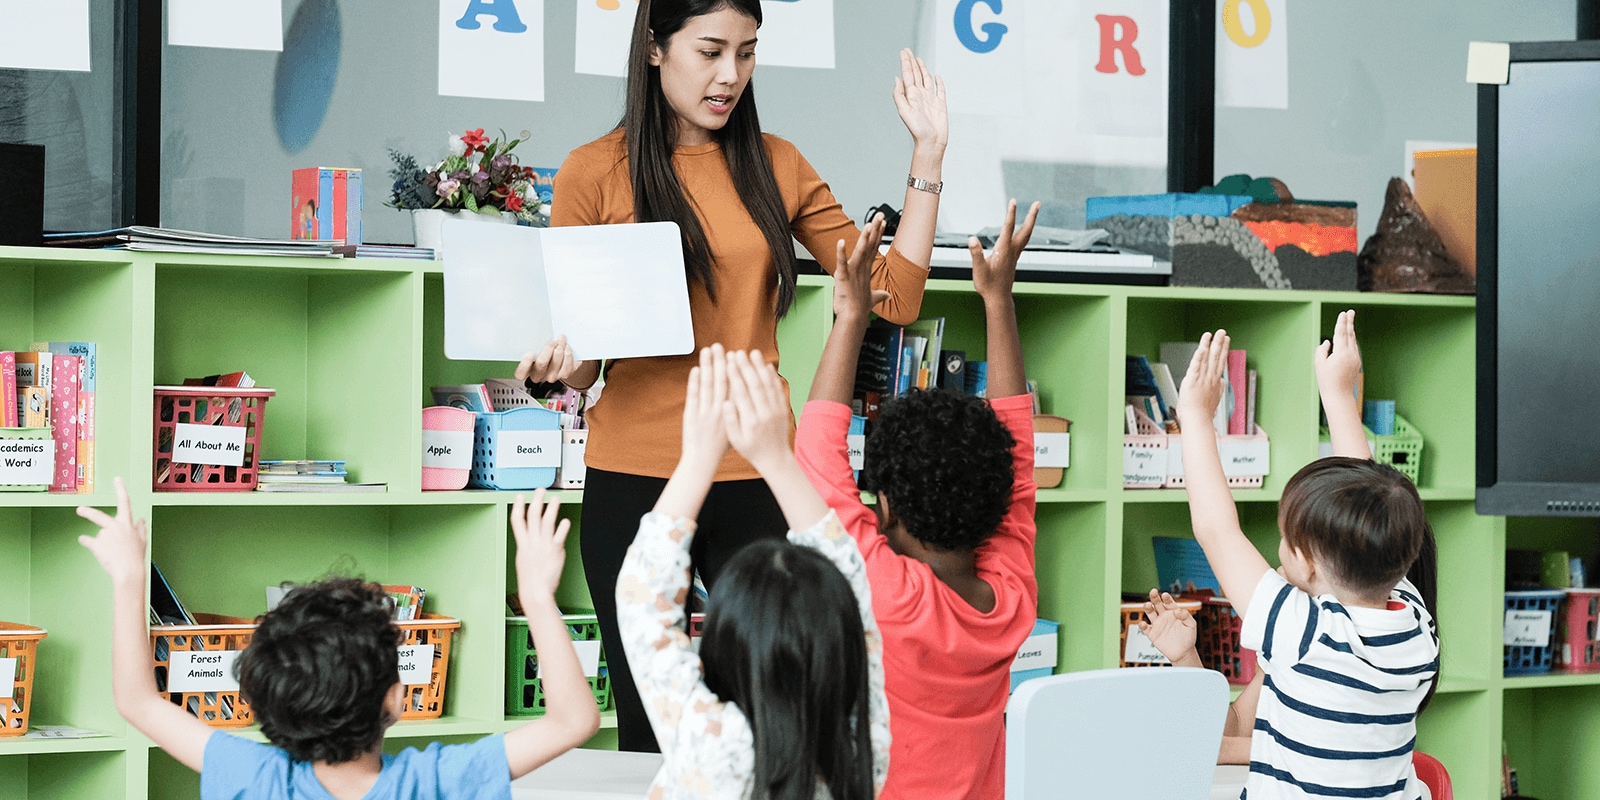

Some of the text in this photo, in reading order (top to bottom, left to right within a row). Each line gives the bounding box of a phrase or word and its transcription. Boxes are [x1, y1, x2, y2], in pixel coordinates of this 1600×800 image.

[456, 0, 527, 33] A
[954, 0, 1008, 53] G
[1096, 14, 1146, 76] R
[0, 443, 44, 453] cademics
[178, 440, 240, 451] All About Me
[427, 445, 452, 456] Apple
[516, 445, 543, 454] Beach
[1035, 446, 1048, 454] Fall
[1131, 450, 1153, 460] Family
[5, 458, 32, 467] Word
[190, 654, 223, 664] Forest
[1018, 650, 1042, 659] Leaves
[187, 668, 224, 678] Animals
